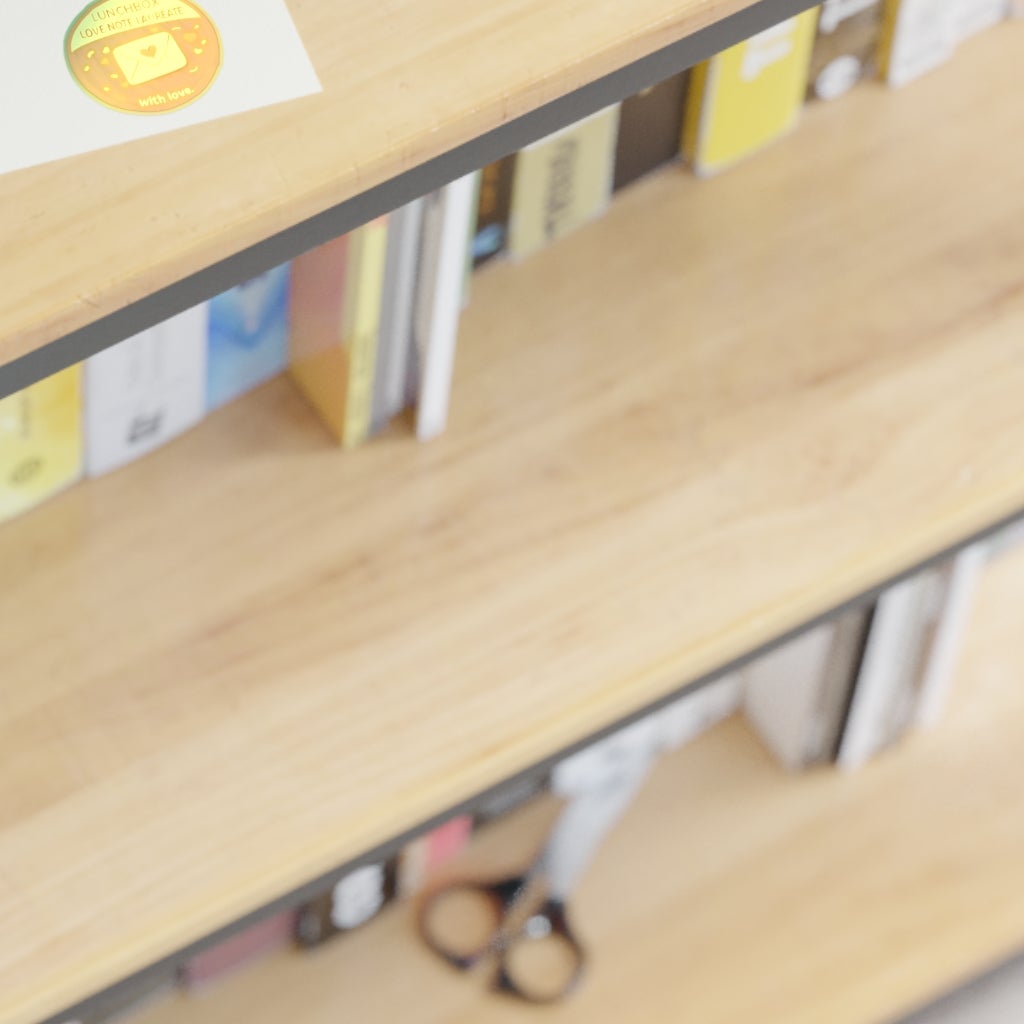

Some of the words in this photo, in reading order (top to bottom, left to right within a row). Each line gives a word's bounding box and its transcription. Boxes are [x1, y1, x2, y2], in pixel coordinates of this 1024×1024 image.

[79, 25, 106, 39] LOVE
[107, 18, 133, 32] NOTE
[137, 93, 167, 108] with
[167, 86, 196, 102] love.
